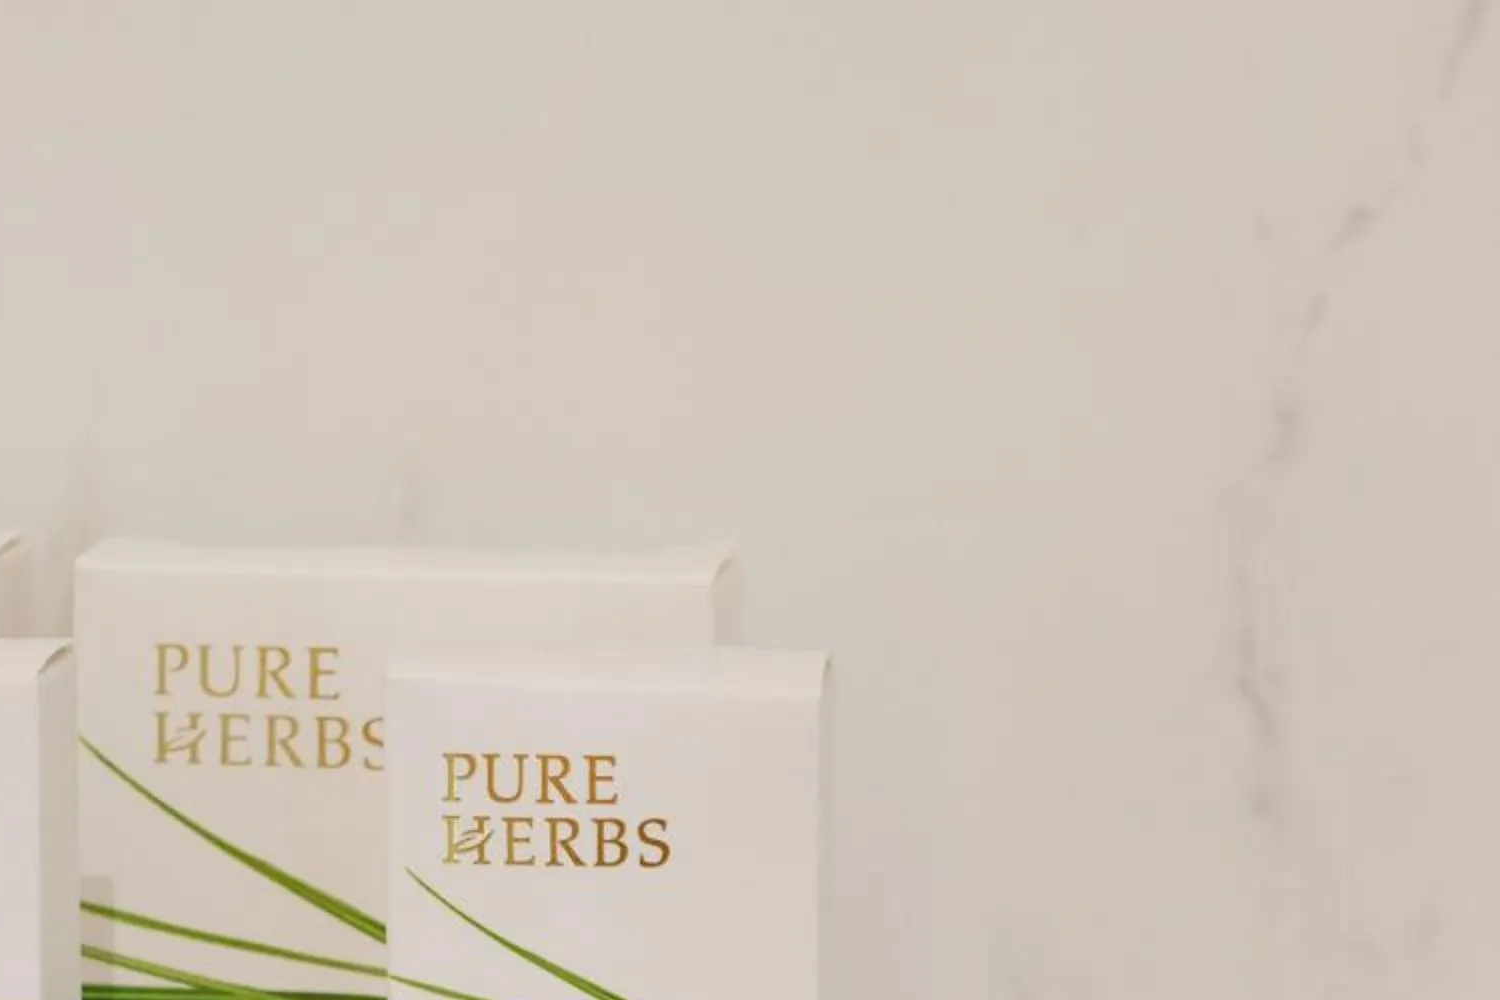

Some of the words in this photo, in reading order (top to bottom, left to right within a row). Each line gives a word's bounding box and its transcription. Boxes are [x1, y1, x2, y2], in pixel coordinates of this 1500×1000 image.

[151, 641, 343, 702] PURE
[151, 710, 385, 772] HERBS
[441, 751, 620, 806] PURE
[441, 814, 673, 869] HERBS
